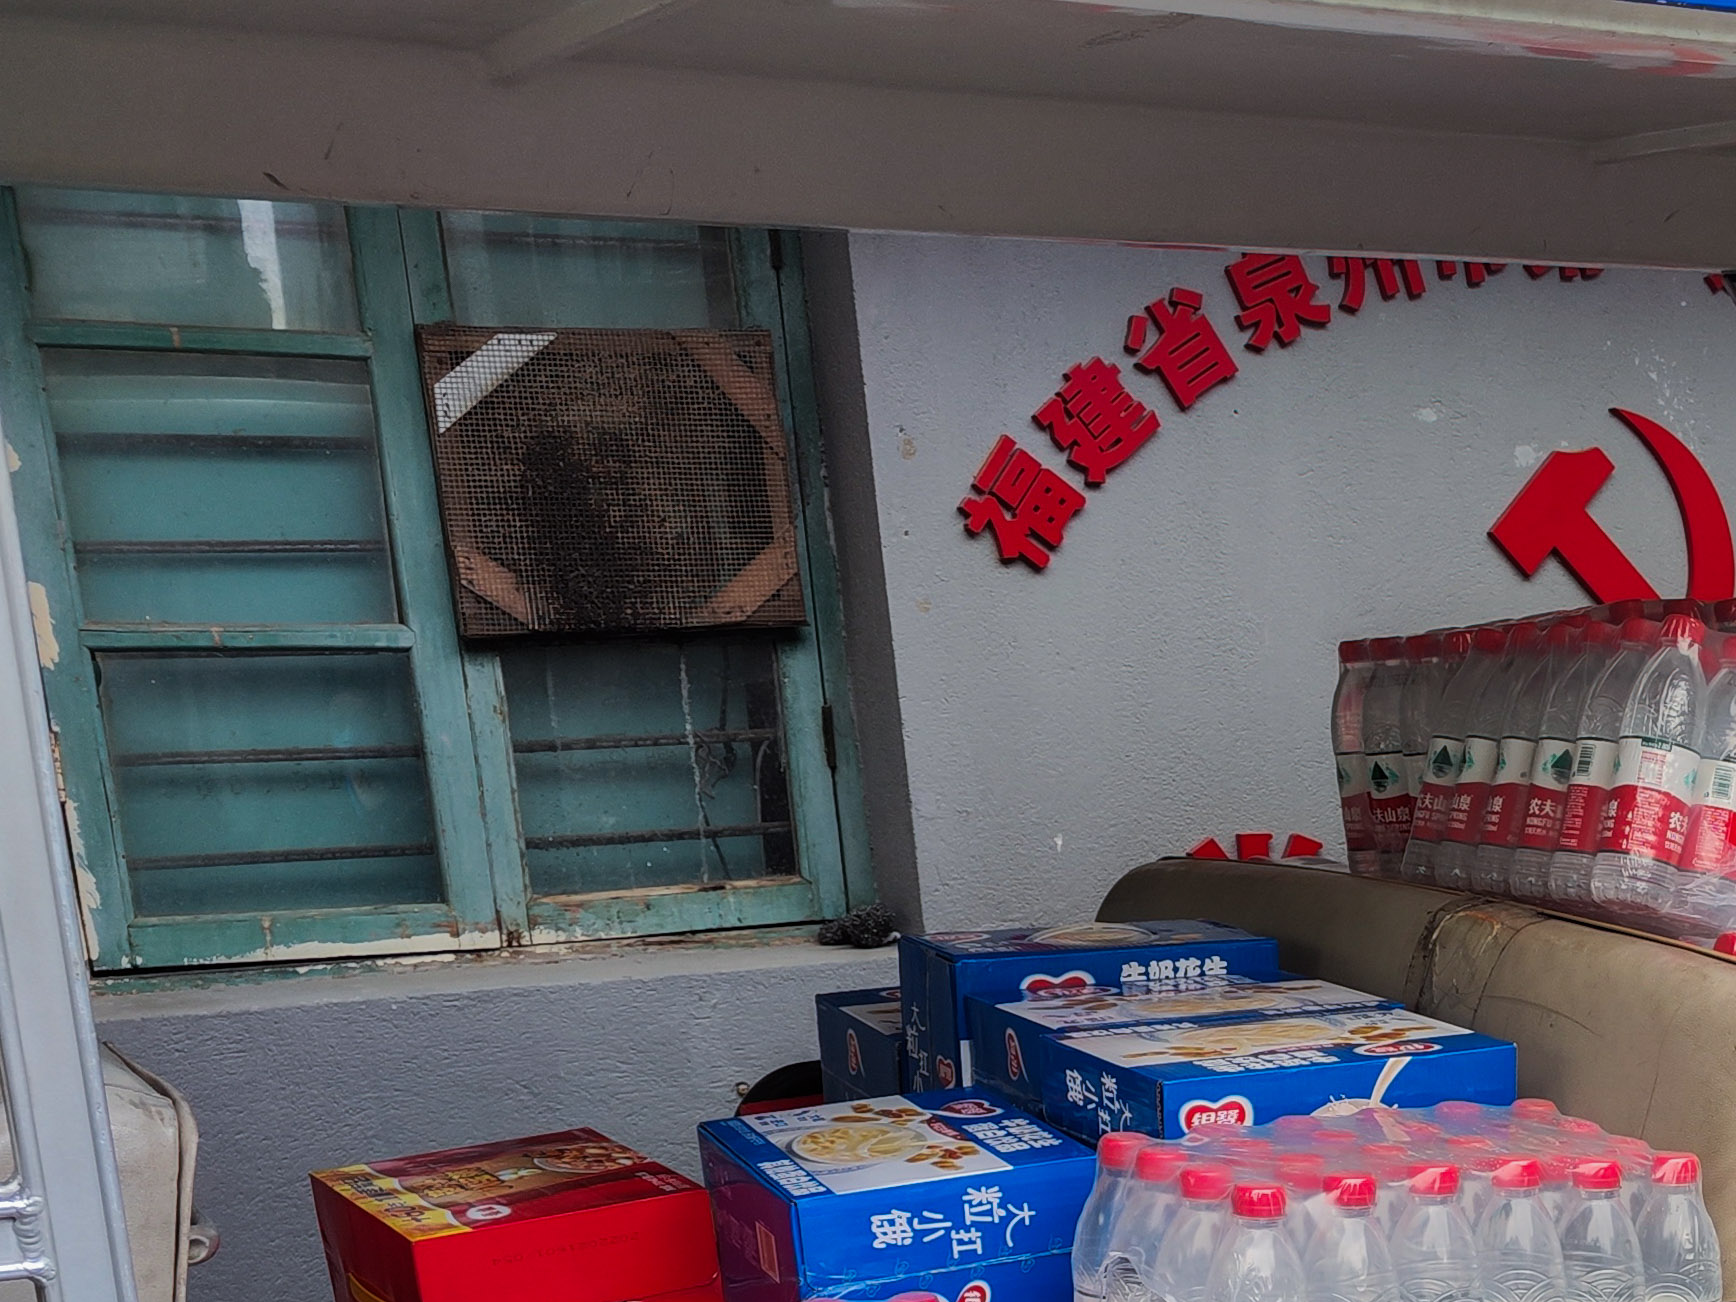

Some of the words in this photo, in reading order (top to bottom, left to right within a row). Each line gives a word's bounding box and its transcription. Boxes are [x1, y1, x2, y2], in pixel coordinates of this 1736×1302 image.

[870, 1185, 1037, 1259] 大粒扛小饿
